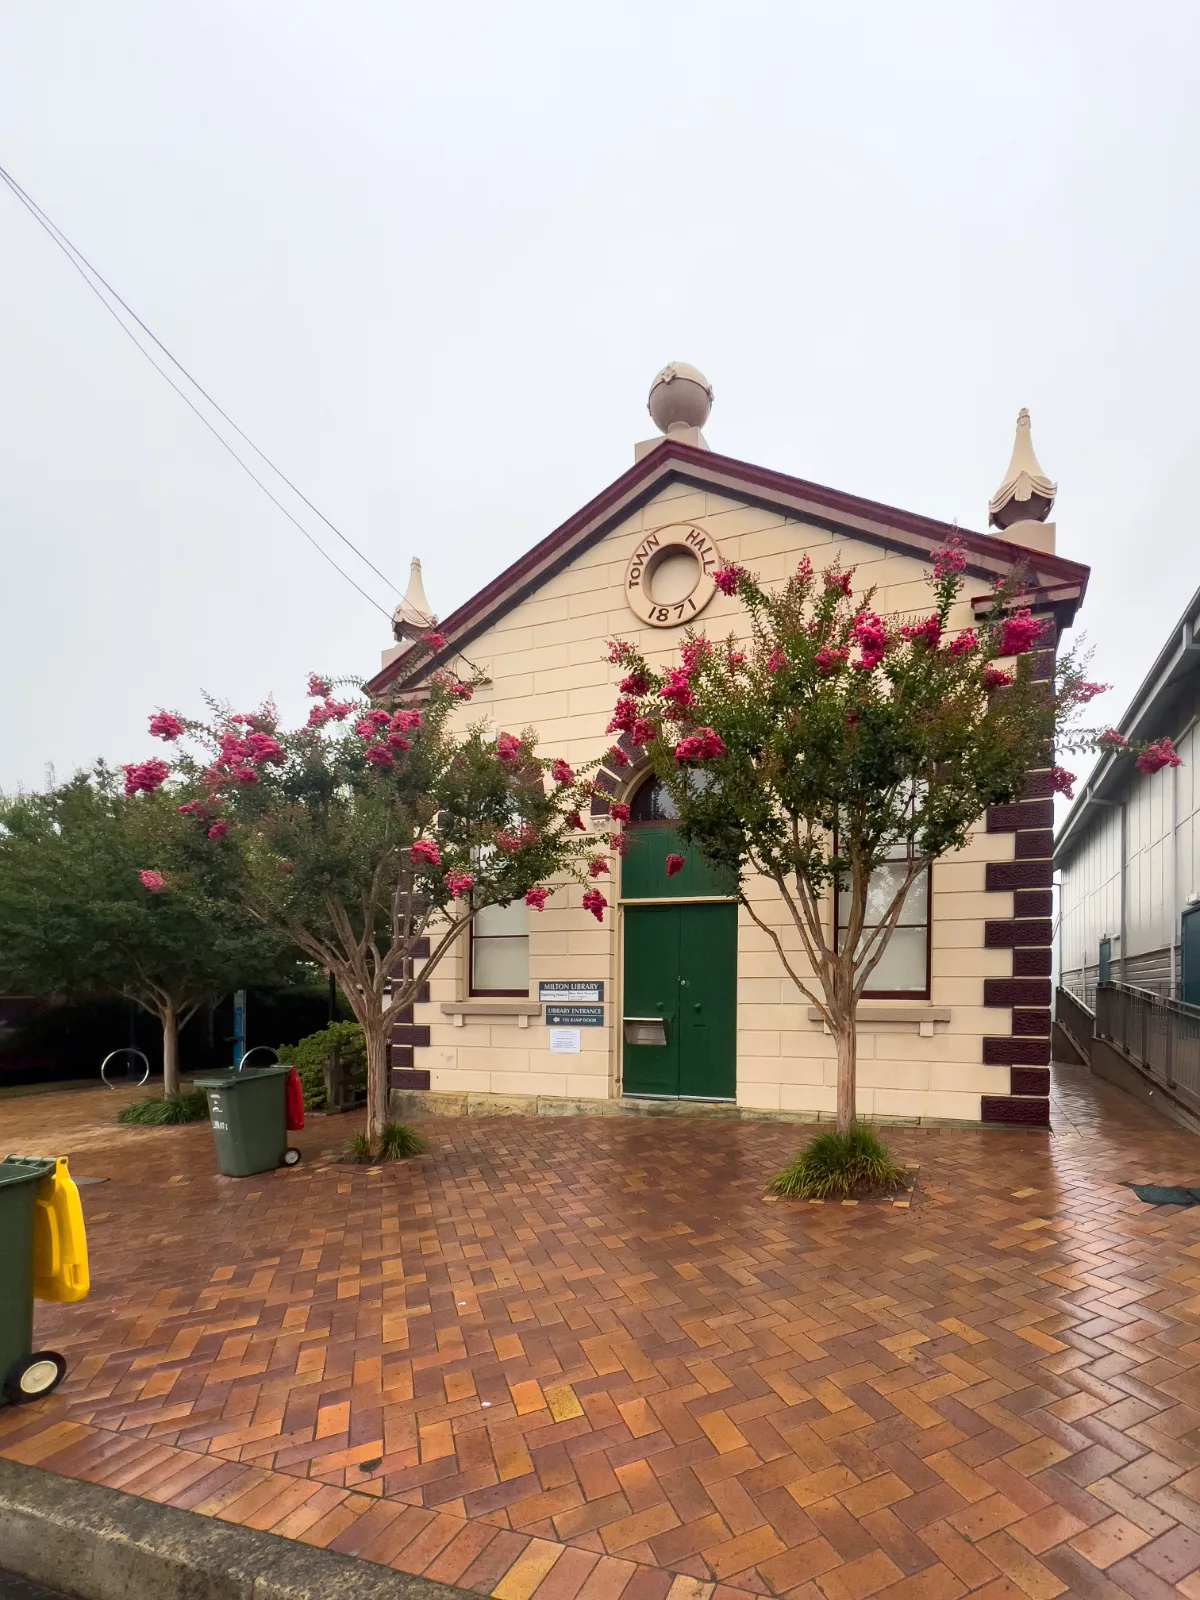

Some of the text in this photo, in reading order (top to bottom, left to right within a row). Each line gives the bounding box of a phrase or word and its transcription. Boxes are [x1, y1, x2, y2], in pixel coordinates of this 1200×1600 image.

[629, 529, 715, 589] TOWN HALL
[648, 598, 697, 622] 1871
